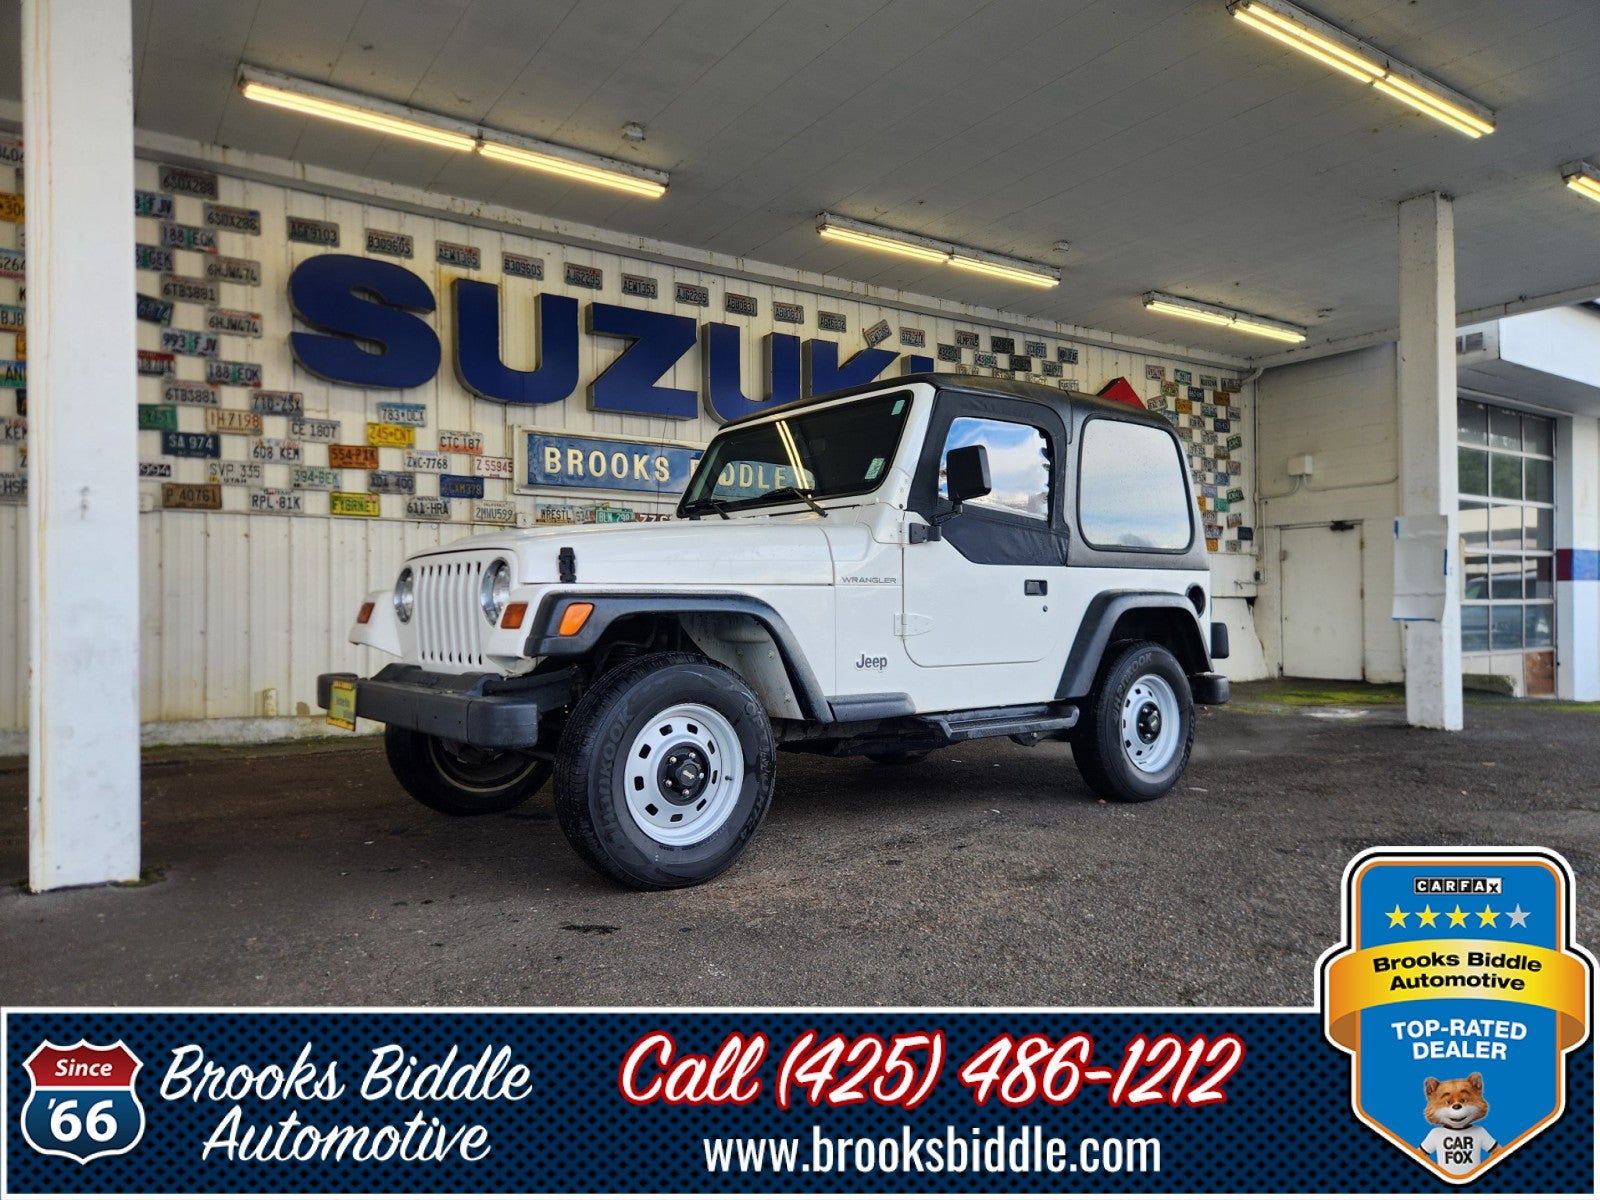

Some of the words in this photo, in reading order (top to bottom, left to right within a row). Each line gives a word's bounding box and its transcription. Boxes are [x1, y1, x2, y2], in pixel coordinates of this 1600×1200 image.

[288, 253, 935, 421] SUZUK
[543, 446, 670, 483] BROOKS
[841, 576, 897, 584] WRANGLER
[856, 653, 888, 671] Jeep
